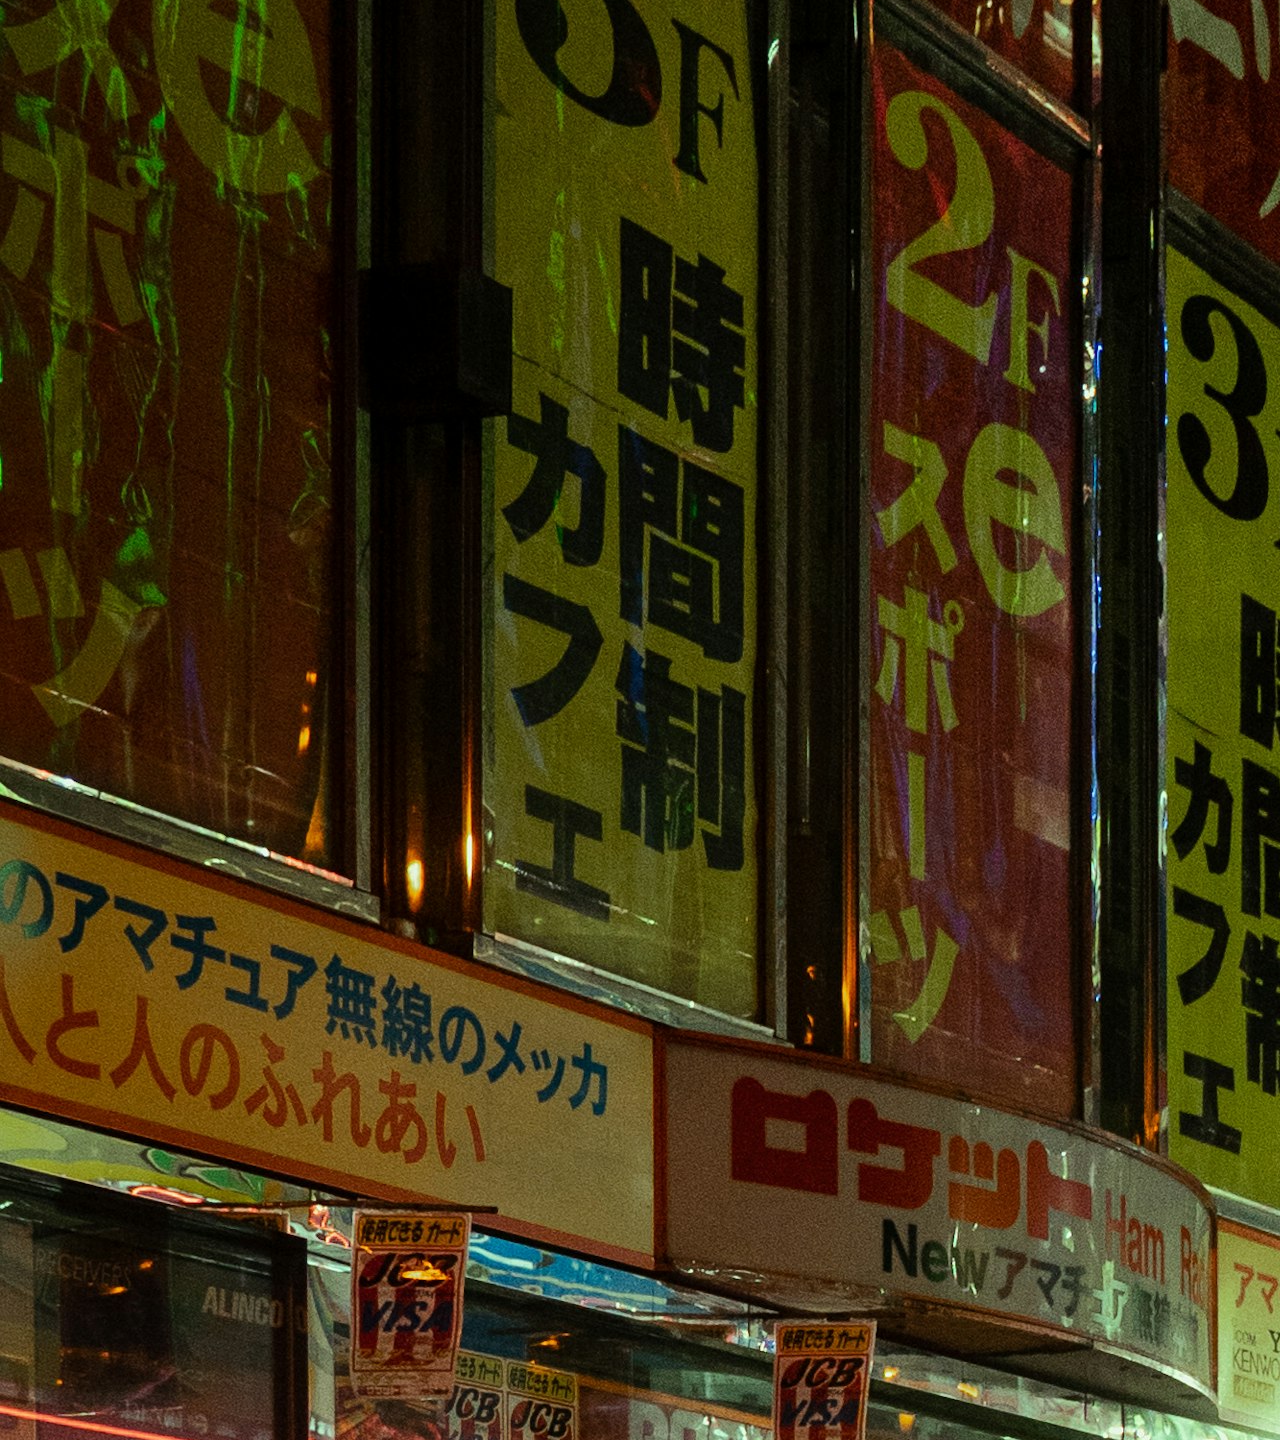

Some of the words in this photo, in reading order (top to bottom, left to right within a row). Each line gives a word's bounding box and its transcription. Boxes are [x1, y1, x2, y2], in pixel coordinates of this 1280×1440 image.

[882, 90, 1062, 393] 2F
[615, 213, 746, 872] 時間制
[962, 420, 1068, 617] e
[501, 395, 611, 923] カフェ
[875, 417, 967, 1044] スポーツ
[0, 860, 609, 1117] のアマチュア無線のメッカ
[1170, 738, 1244, 1157] カフェ
[731, 1076, 1093, 1242] ロケット
[361, 1219, 423, 1244] 使用できる
[426, 1220, 464, 1245] カード
[1105, 1188, 1166, 1286] Ham
[200, 1285, 284, 1328] ALINCO
[361, 1300, 453, 1333] VISA
[781, 1326, 834, 1350] 使用できる
[837, 1330, 869, 1348] カード
[508, 1365, 546, 1393] 使用できる
[510, 1399, 573, 1438] JCB
[780, 1357, 862, 1389] JCB
[780, 1397, 860, 1431] VISA
